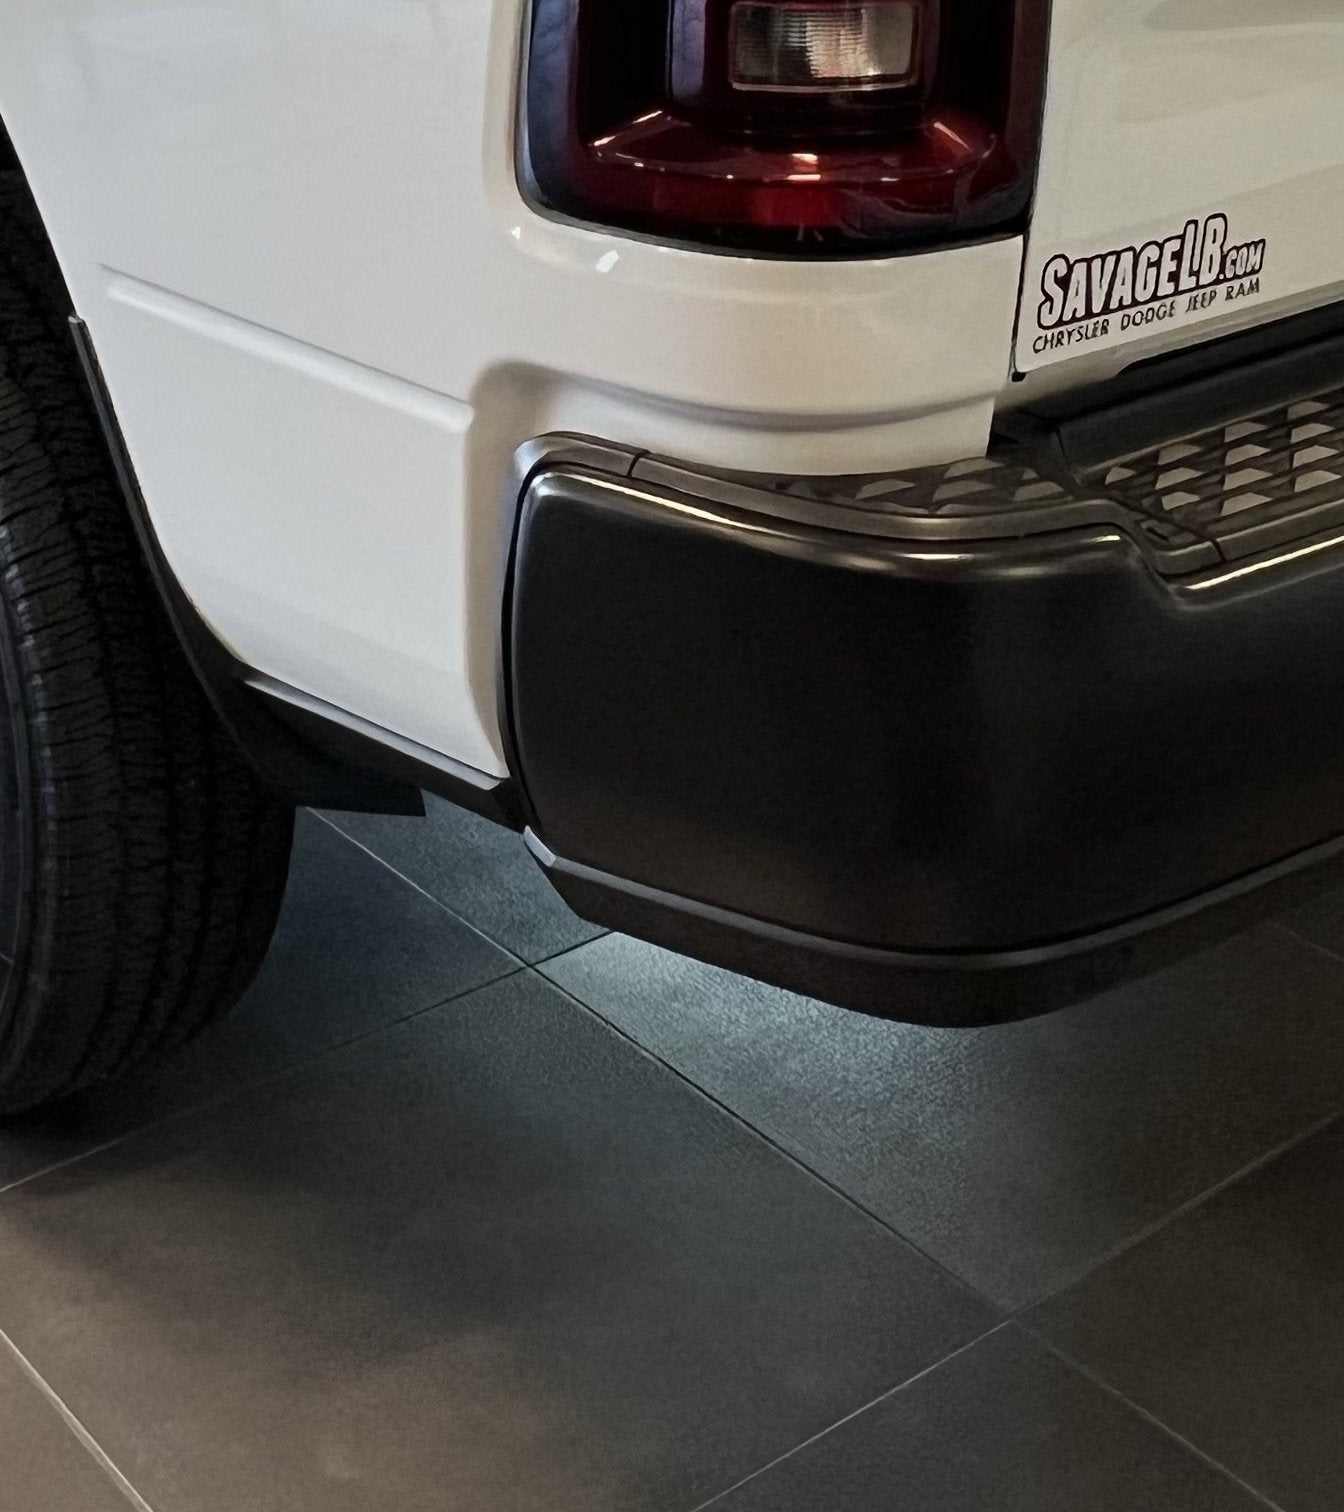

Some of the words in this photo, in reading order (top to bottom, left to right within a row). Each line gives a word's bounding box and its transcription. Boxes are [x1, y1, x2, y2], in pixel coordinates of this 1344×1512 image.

[1032, 317, 1110, 354] CHRYSLER
[1120, 303, 1176, 331] DODGE
[1184, 290, 1217, 314] JEEP
[1224, 277, 1260, 301] RAM
[1037, 212, 1266, 331] SAVAGELB.COM
